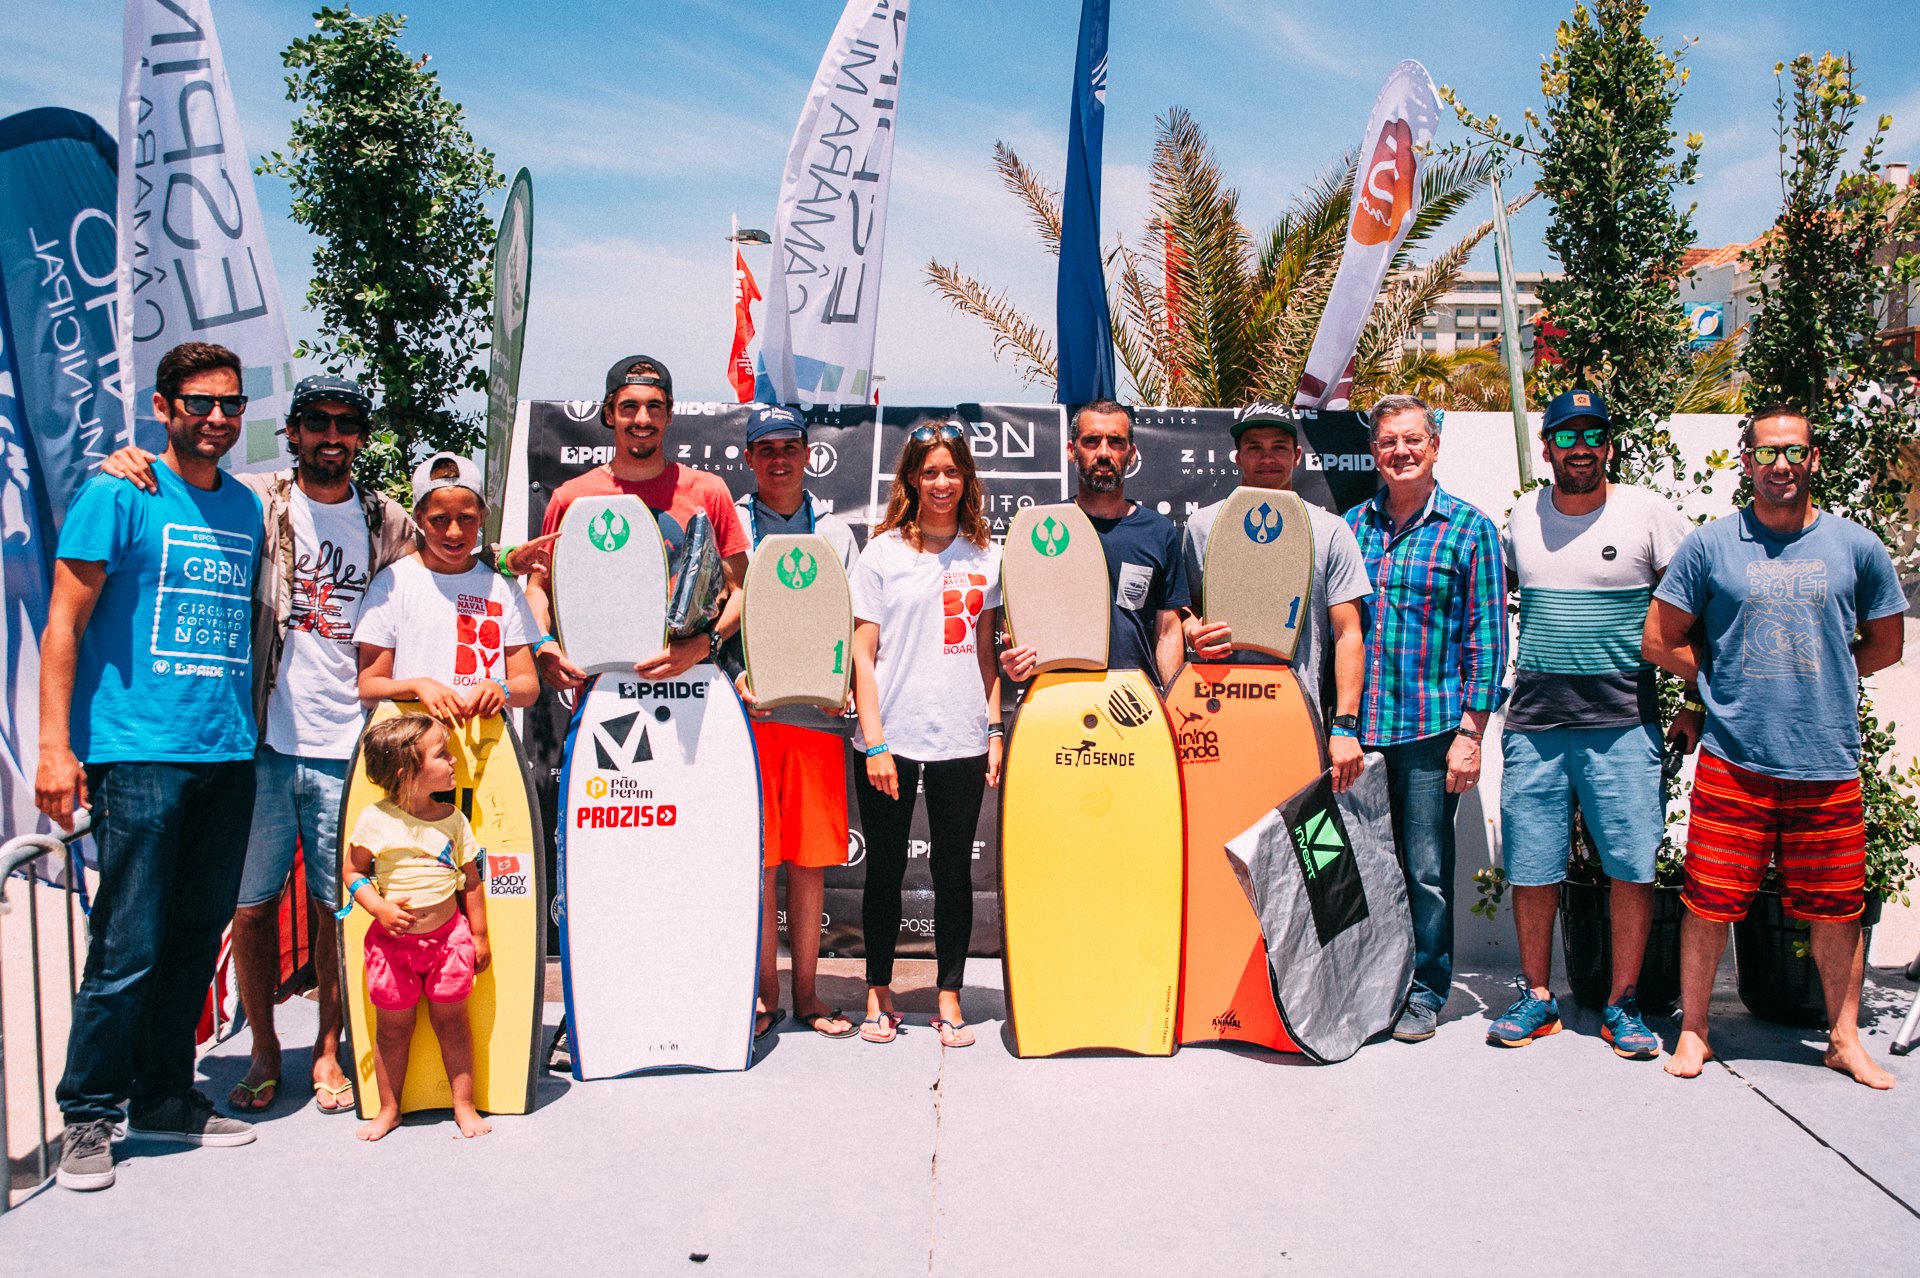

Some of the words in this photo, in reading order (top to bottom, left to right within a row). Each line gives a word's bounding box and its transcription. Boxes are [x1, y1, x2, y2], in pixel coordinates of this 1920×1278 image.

[677, 445, 739, 459] ZIO
[1181, 467, 1239, 475] wetsu
[1323, 453, 1375, 471] PRID
[183, 556, 247, 588] CBBN
[178, 602, 245, 621] CIRCUITO
[457, 601, 486, 611] NAVAL
[1285, 596, 1300, 629] 1
[832, 640, 844, 674] 1
[577, 806, 654, 828] PROZIS
[491, 875, 527, 886] BODY
[491, 886, 527, 895] BOARD
